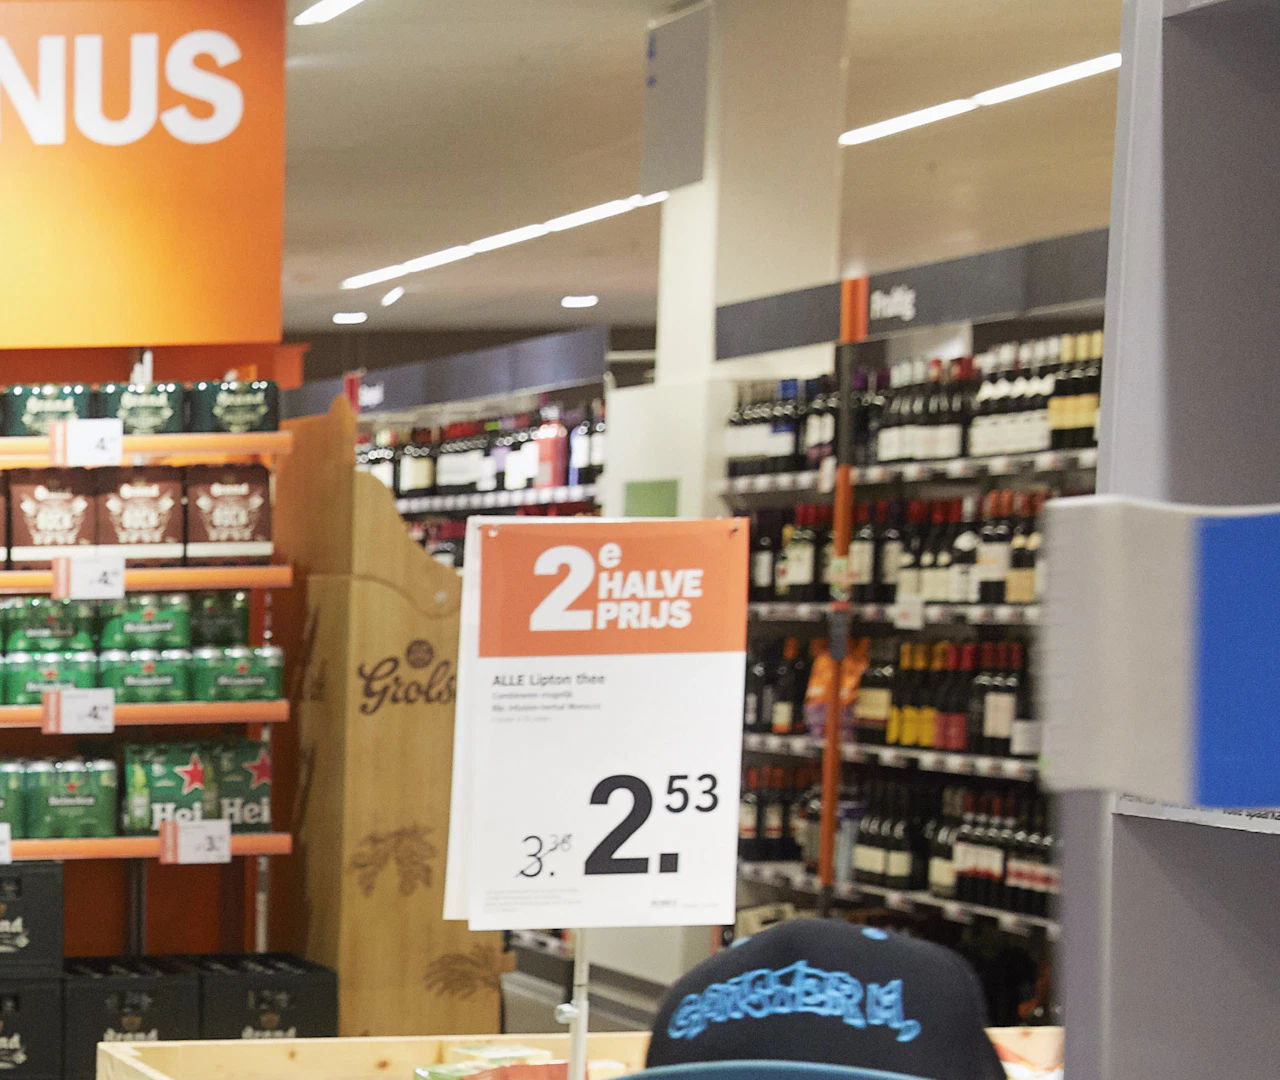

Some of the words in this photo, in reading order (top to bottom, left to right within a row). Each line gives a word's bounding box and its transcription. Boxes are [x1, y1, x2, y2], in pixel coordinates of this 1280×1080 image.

[598, 568, 704, 600] HALVE
[597, 597, 693, 631] PRIJS
[357, 657, 457, 716] Grols
[492, 674, 525, 687] ALLE
[529, 672, 572, 688] Lipton
